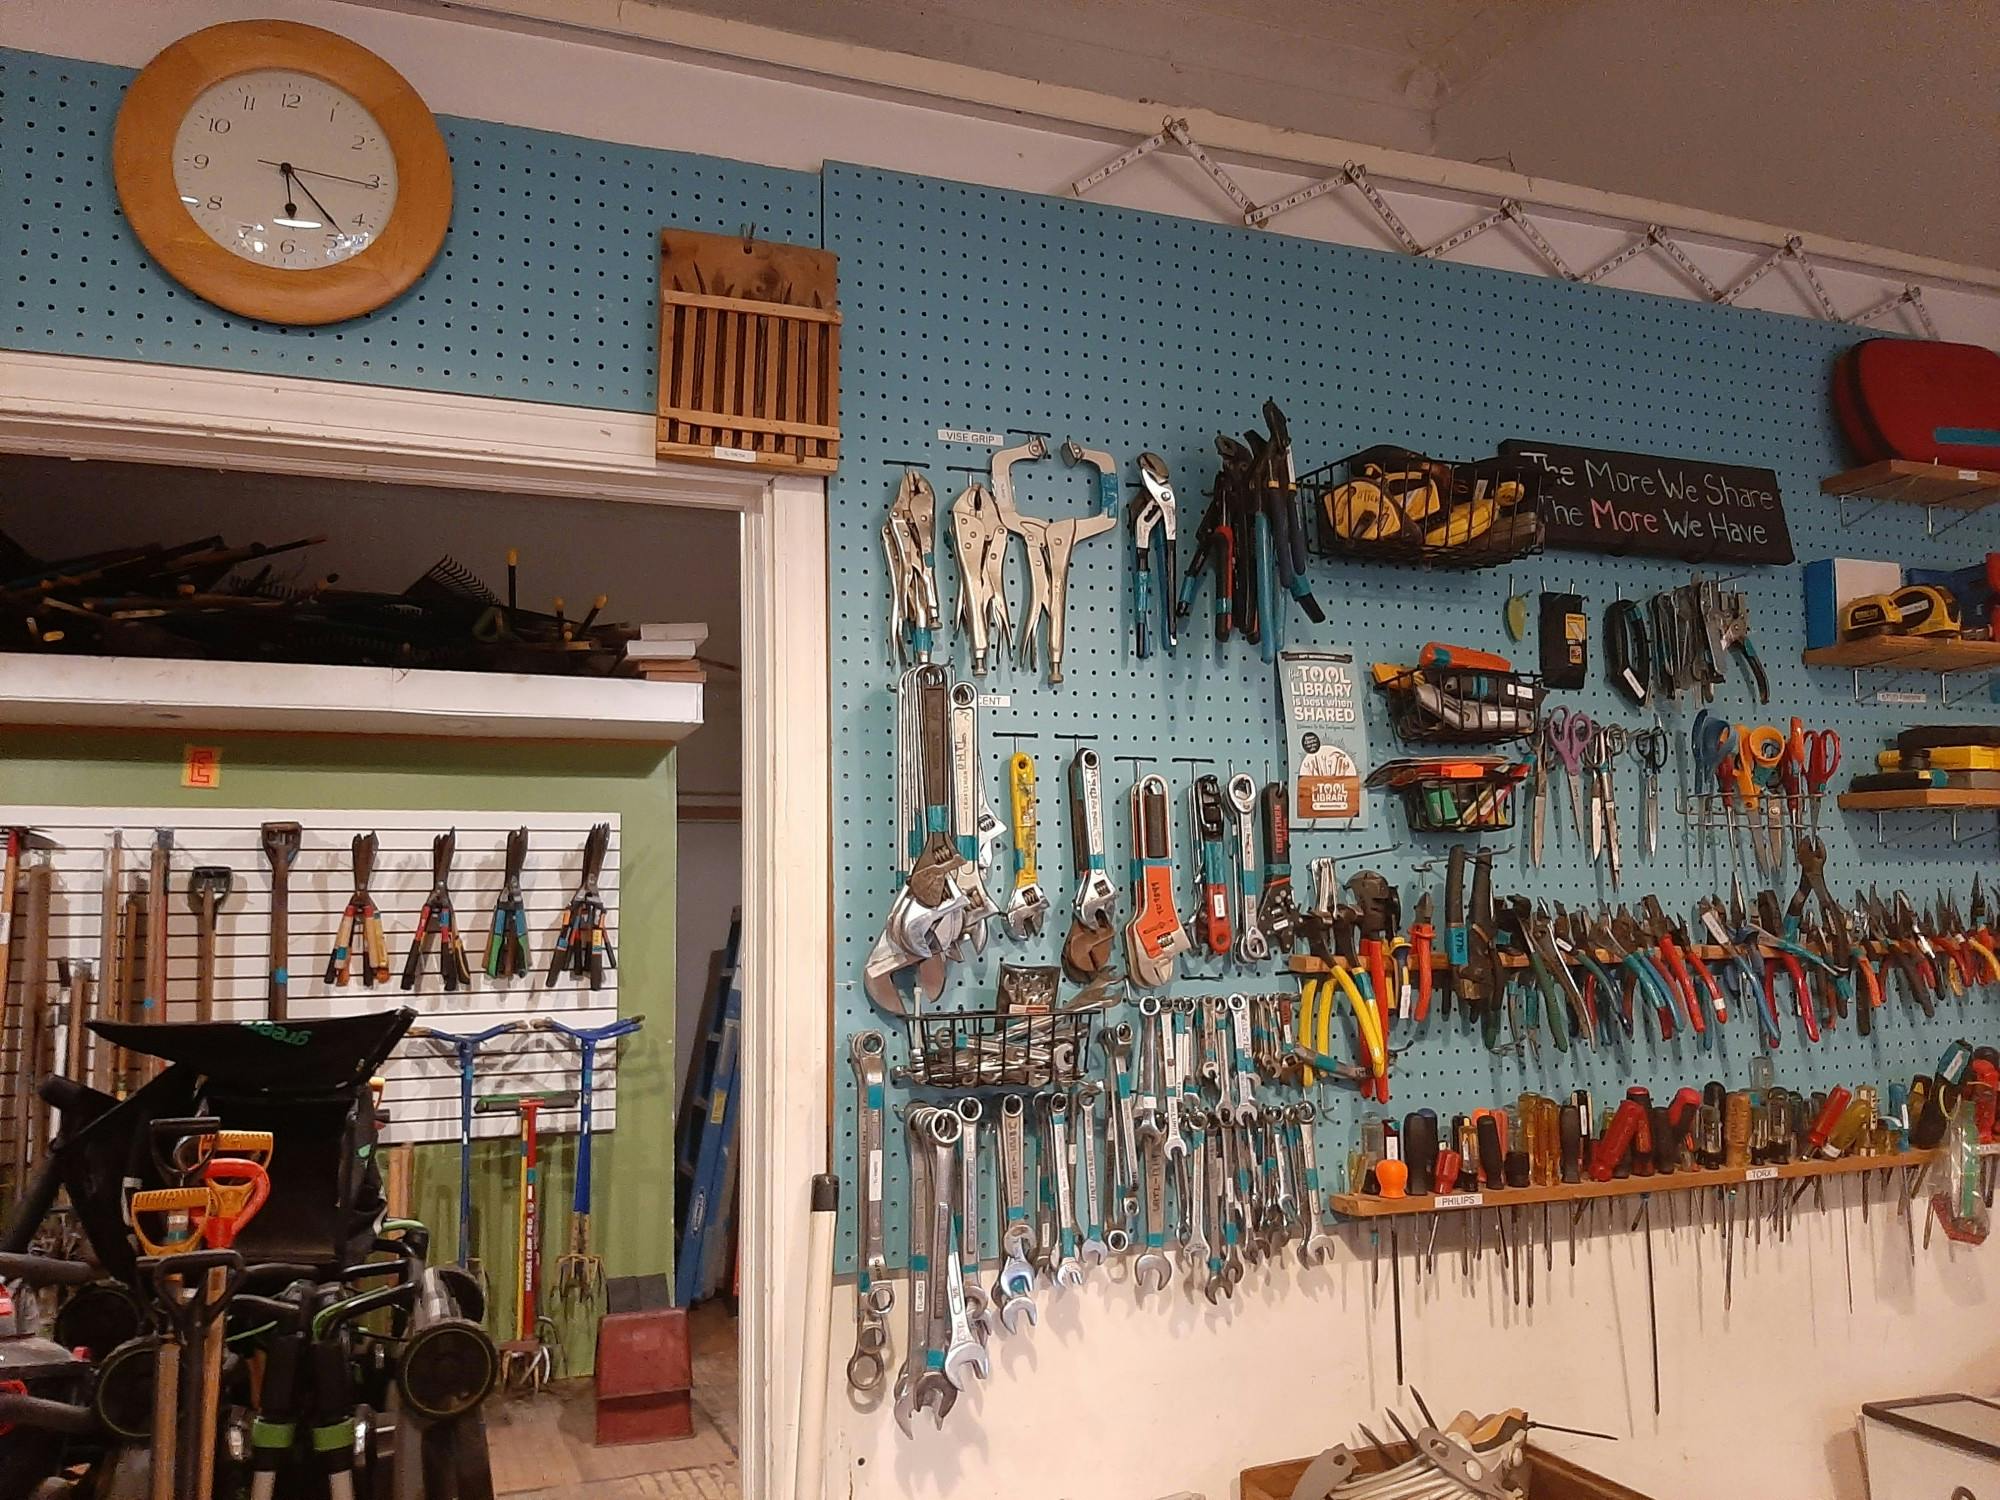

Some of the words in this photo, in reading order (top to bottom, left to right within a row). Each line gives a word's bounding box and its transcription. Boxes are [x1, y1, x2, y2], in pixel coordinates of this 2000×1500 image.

[243, 95, 256, 111] 11
[281, 93, 301, 109] 12
[329, 107, 336, 123] 1
[208, 117, 231, 134] 10
[352, 135, 366, 151] 2
[193, 153, 210, 170] 9
[365, 174, 381, 190] 3
[206, 195, 222, 211] 8
[352, 212, 366, 226] 4
[279, 239, 296, 255] 6
[946, 431, 969, 441] VISE
[971, 434, 995, 444] GRIP
[1519, 451, 1575, 486] The
[1584, 458, 1656, 497] More
[1657, 467, 1699, 503] We
[1703, 473, 1775, 511] Share
[1590, 498, 1658, 534] More
[1662, 508, 1704, 540] We
[1708, 511, 1768, 545] Have
[1298, 665, 1352, 683] TOOL
[1291, 682, 1352, 698] LIBRARY
[1292, 696, 1301, 707] is
[1303, 696, 1325, 708] best
[1327, 697, 1353, 709] when
[1294, 706, 1356, 722] SHARED
[191, 751, 213, 783] E
[1317, 783, 1348, 794] TOOL
[1311, 793, 1348, 802] LIBRARY
[1751, 1169, 1772, 1179] TORX
[1441, 1195, 1475, 1207] PHILIPS
